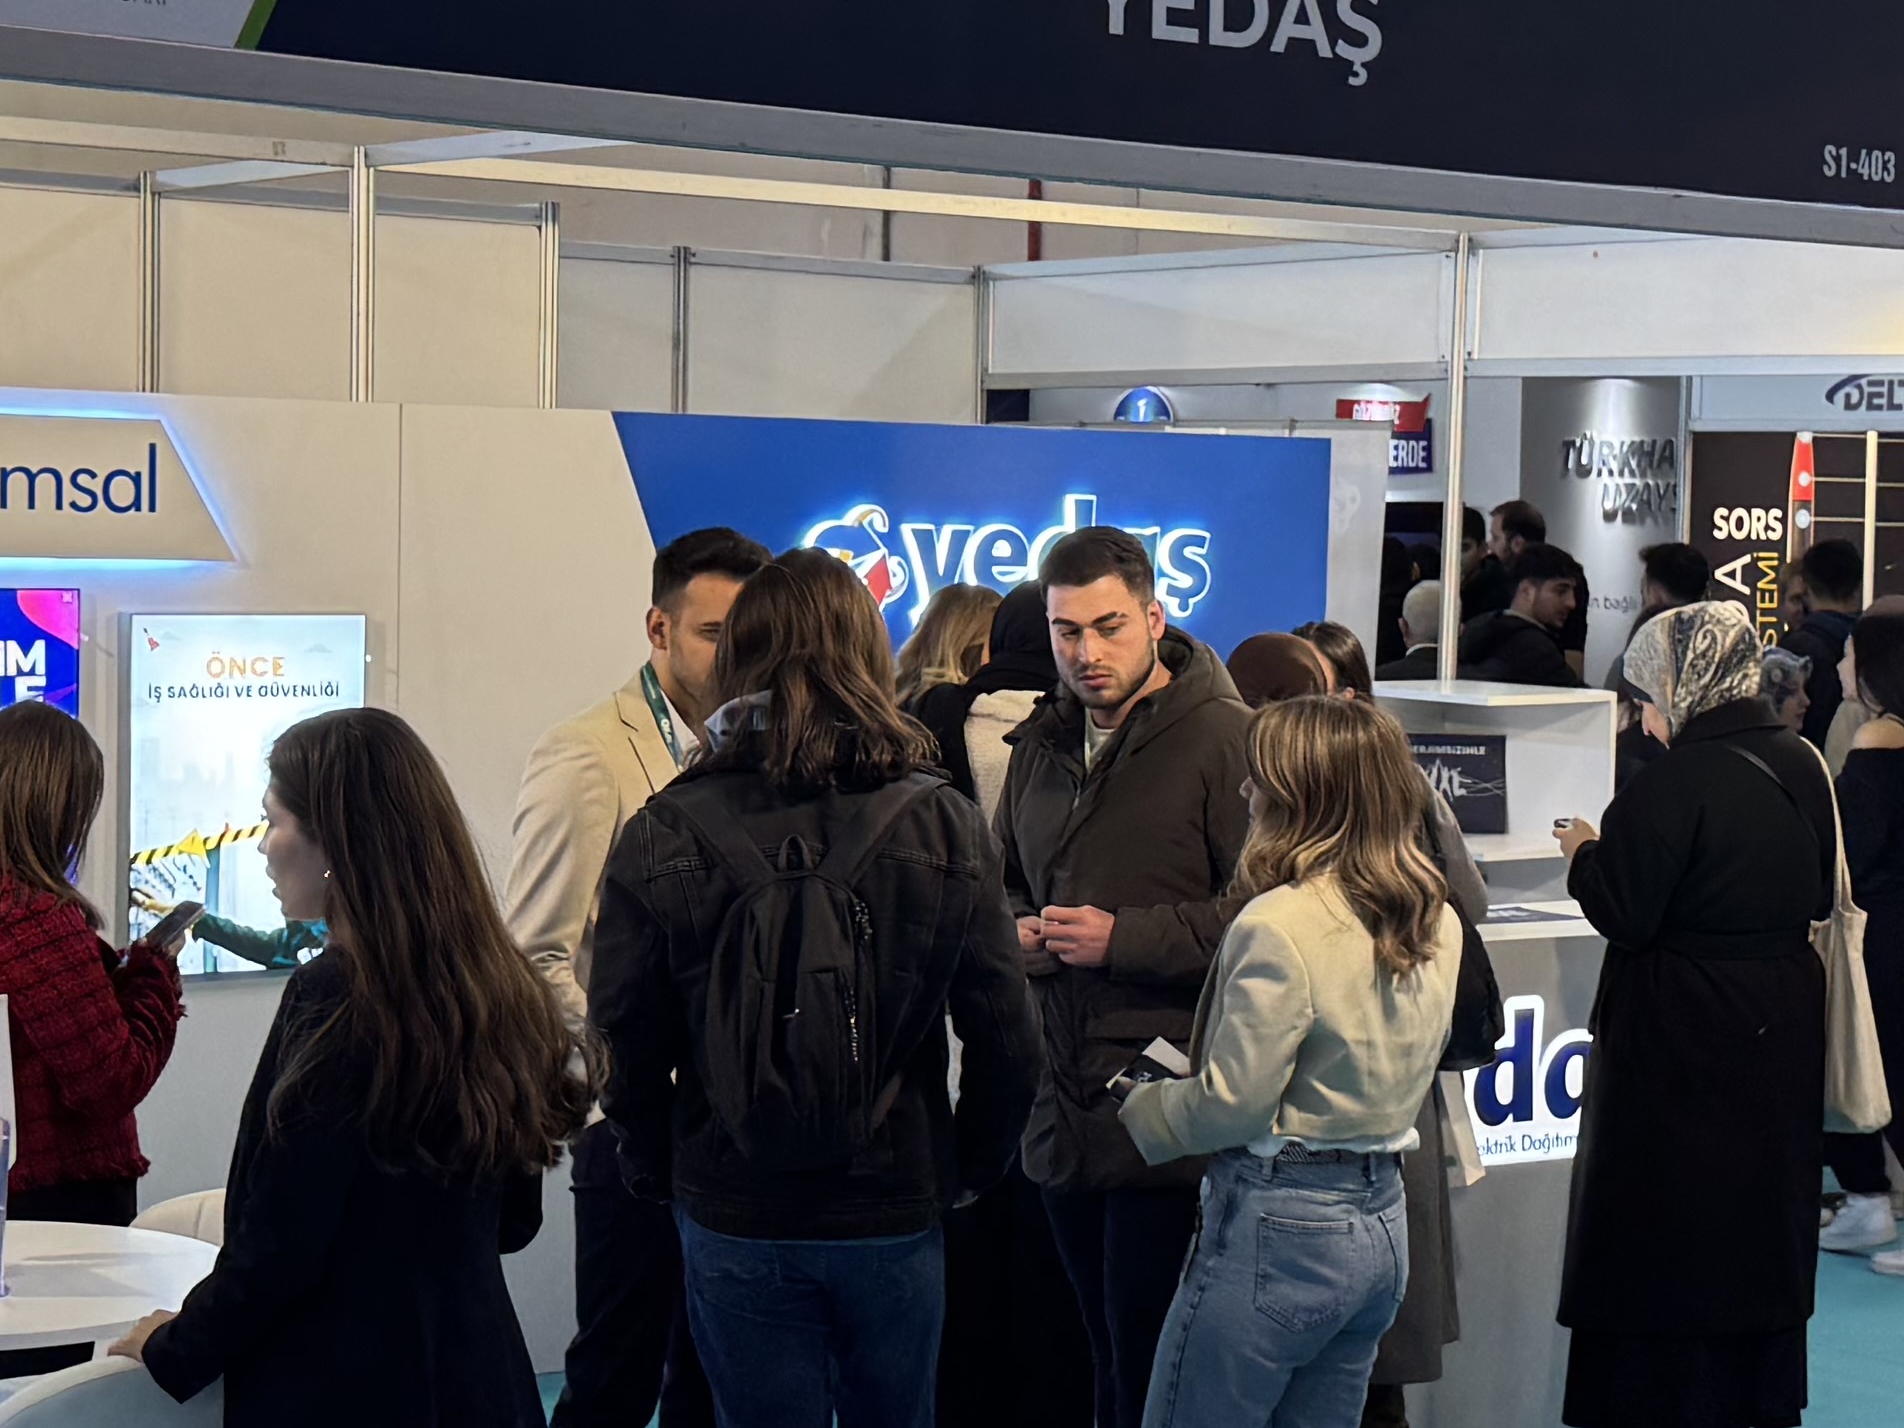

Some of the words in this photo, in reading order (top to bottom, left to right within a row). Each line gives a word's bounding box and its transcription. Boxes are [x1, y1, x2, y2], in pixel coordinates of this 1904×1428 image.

[1823, 143, 1896, 184] S1-403
[1712, 506, 1783, 541] SORS
[206, 651, 285, 679] ÖNCE
[148, 683, 162, 703] İŞ
[168, 682, 230, 698] SAĞLIĞI
[234, 684, 253, 698] VE
[258, 681, 340, 699] GÜVENLİĞİ
